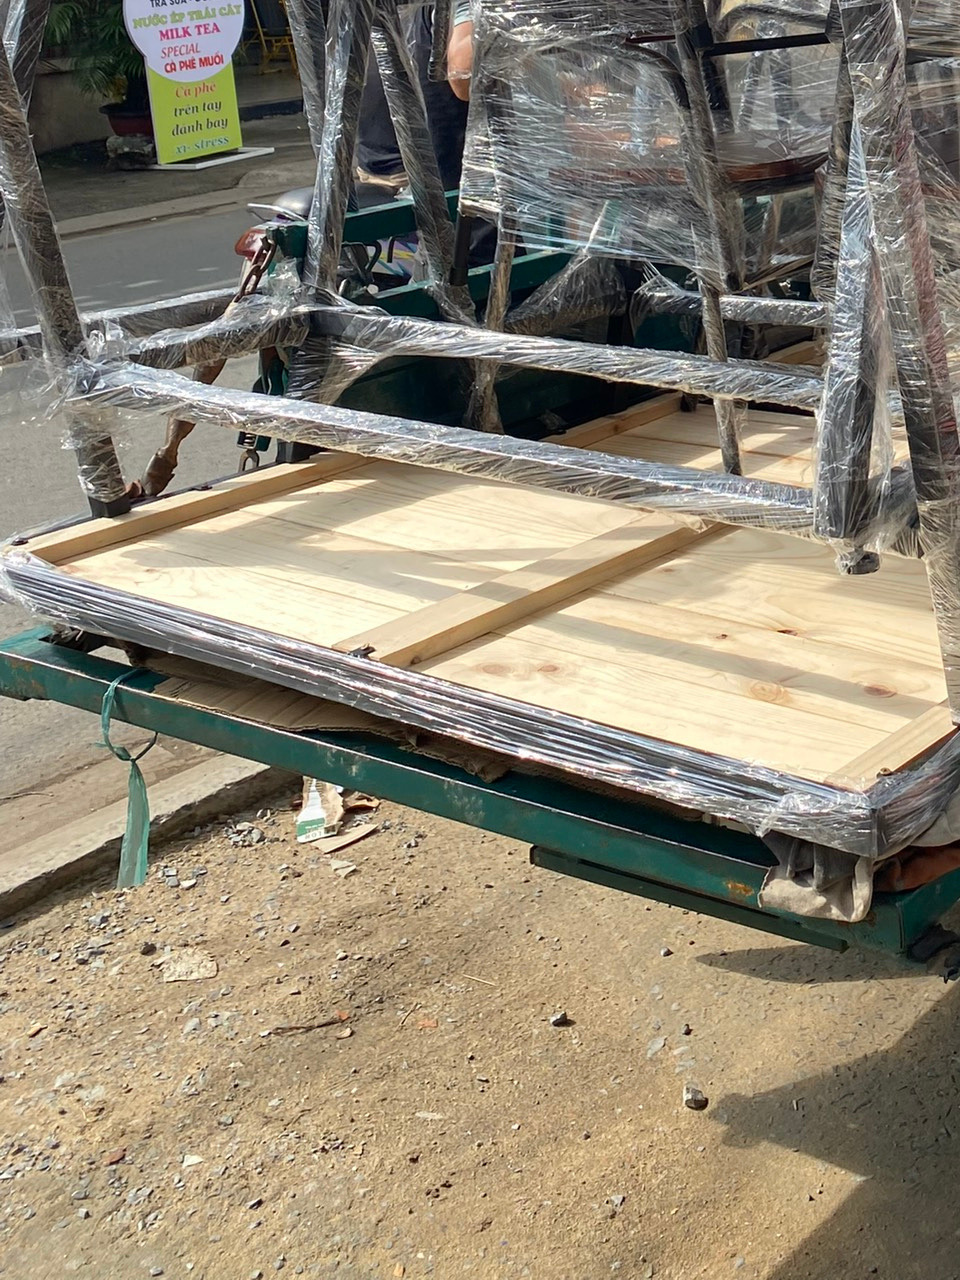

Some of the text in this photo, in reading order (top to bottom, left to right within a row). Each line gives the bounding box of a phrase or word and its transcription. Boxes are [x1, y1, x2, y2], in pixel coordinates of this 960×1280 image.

[188, 7, 217, 21] TRÁI
[219, 4, 242, 17] CÂY
[159, 22, 221, 42] MILK TEA
[161, 43, 200, 59] SPECIAL
[164, 51, 224, 74] CÀ PHÊ MUỐI
[194, 80, 217, 97] phê
[174, 101, 222, 117] trên tay
[206, 118, 228, 129] bay
[194, 136, 229, 151] stress
